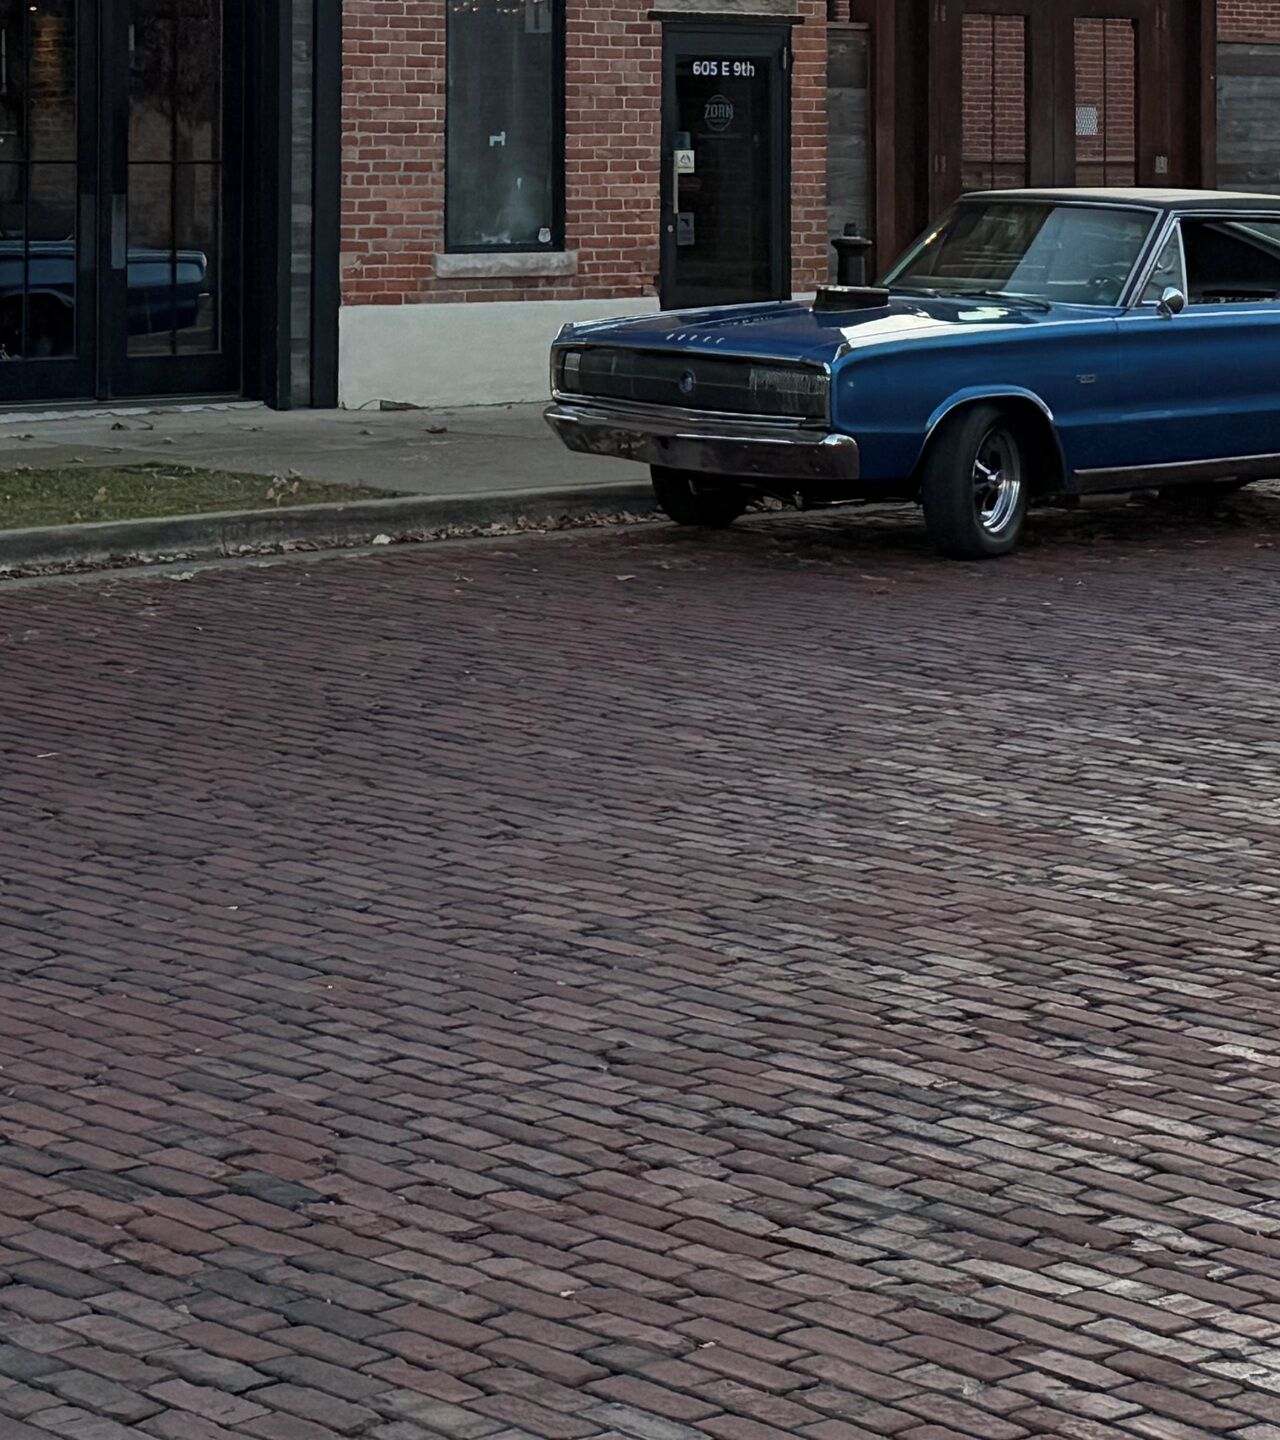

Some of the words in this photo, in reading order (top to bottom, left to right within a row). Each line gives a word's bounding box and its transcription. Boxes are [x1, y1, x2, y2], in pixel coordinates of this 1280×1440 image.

[692, 61, 718, 76] 605
[721, 61, 730, 76] E
[733, 61, 755, 77] 9th
